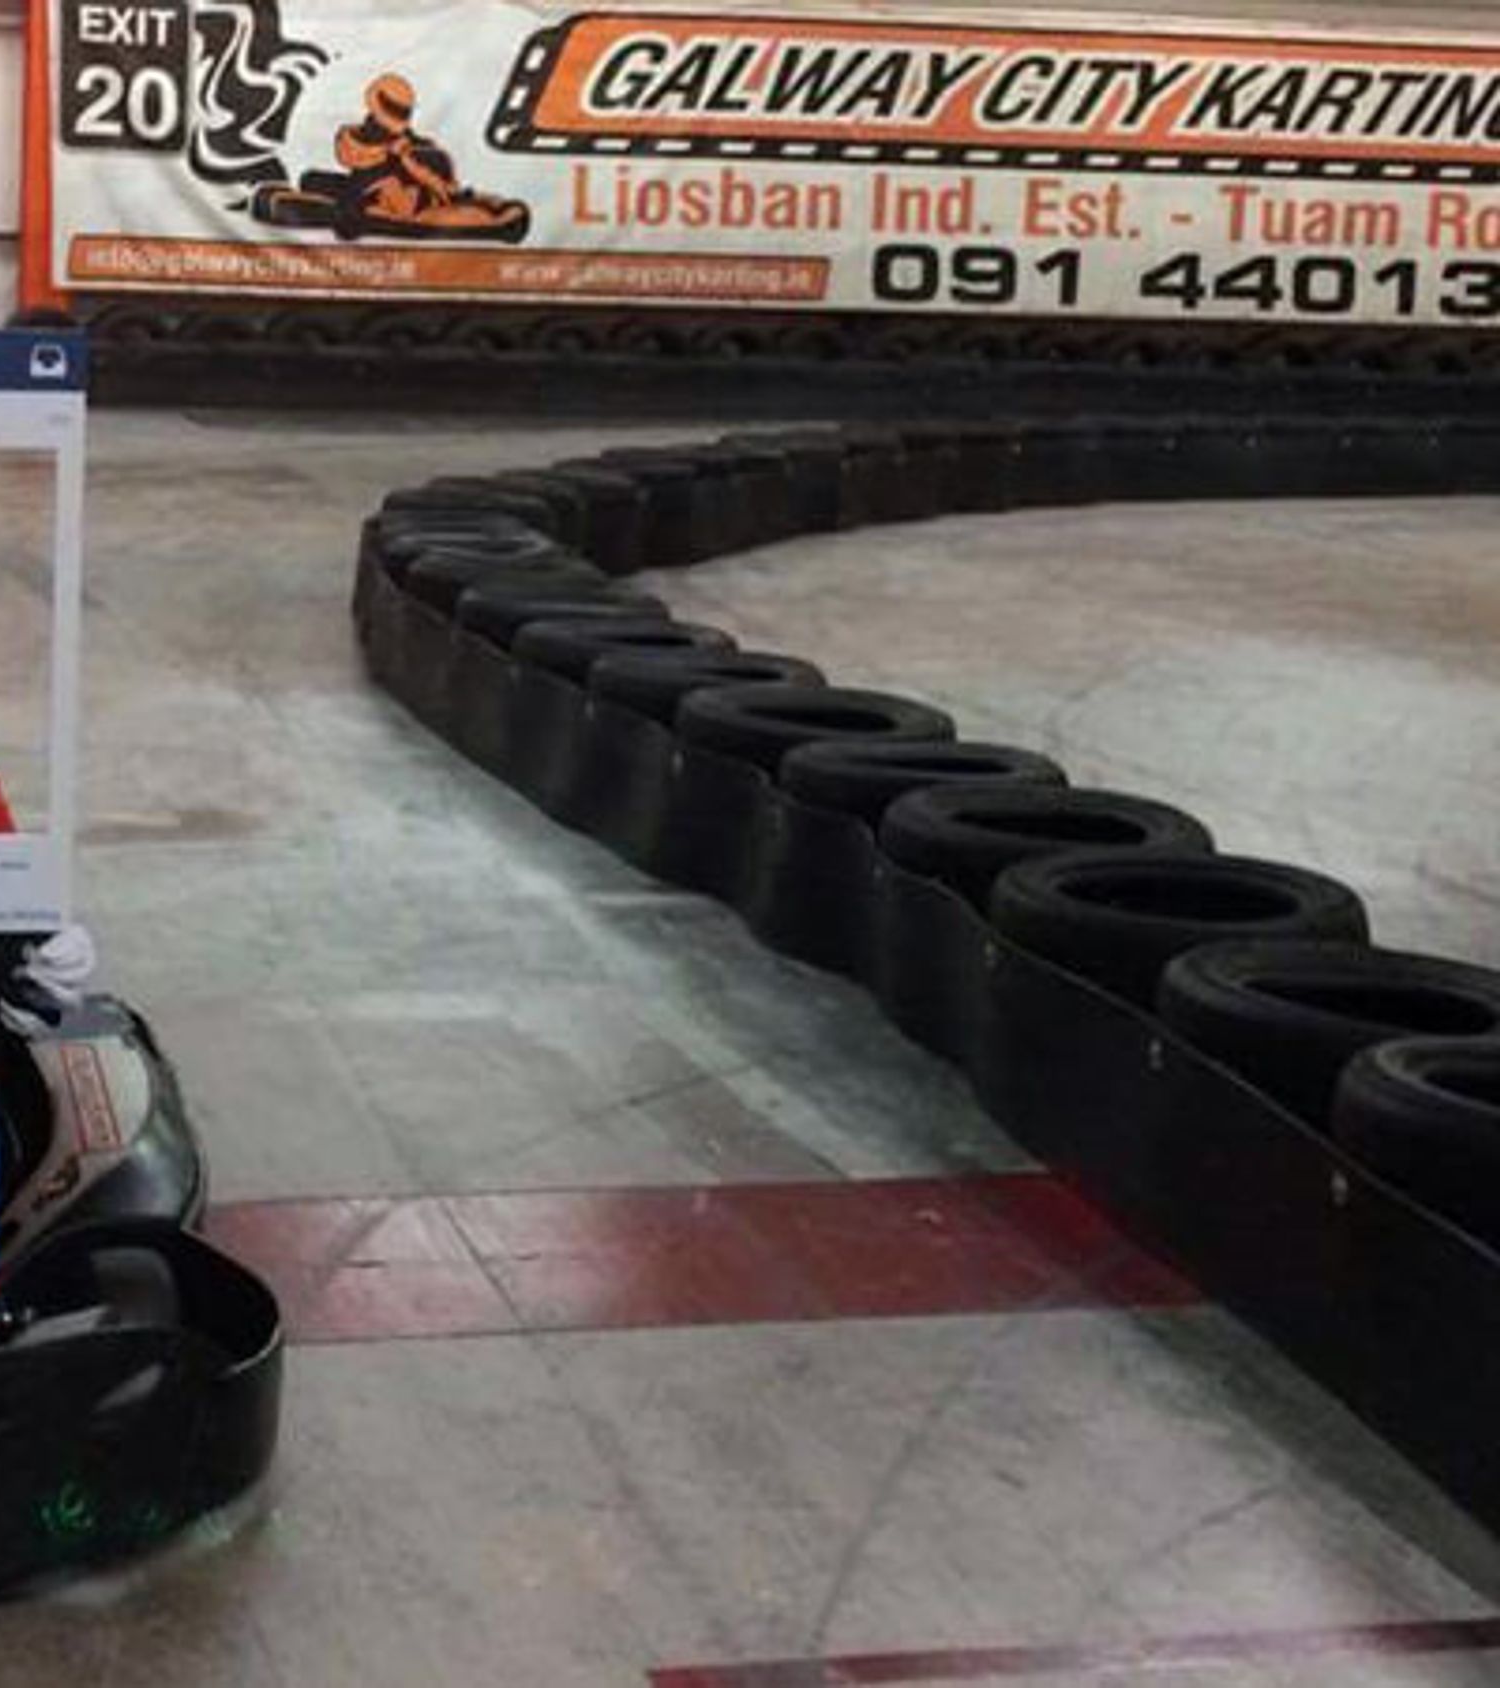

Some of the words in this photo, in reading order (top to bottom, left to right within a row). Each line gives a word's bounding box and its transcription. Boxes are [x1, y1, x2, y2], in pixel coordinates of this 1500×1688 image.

[79, 6, 176, 46] EXIT
[75, 65, 178, 139] 20
[589, 40, 985, 118] GALWAY
[981, 55, 1192, 126] CITY
[572, 165, 841, 230] Liosban
[871, 173, 993, 235] Ind.
[1023, 179, 1141, 239] Est.
[1219, 185, 1399, 247] Tuam
[871, 244, 1081, 306] 091
[1140, 252, 1500, 317] 44013
